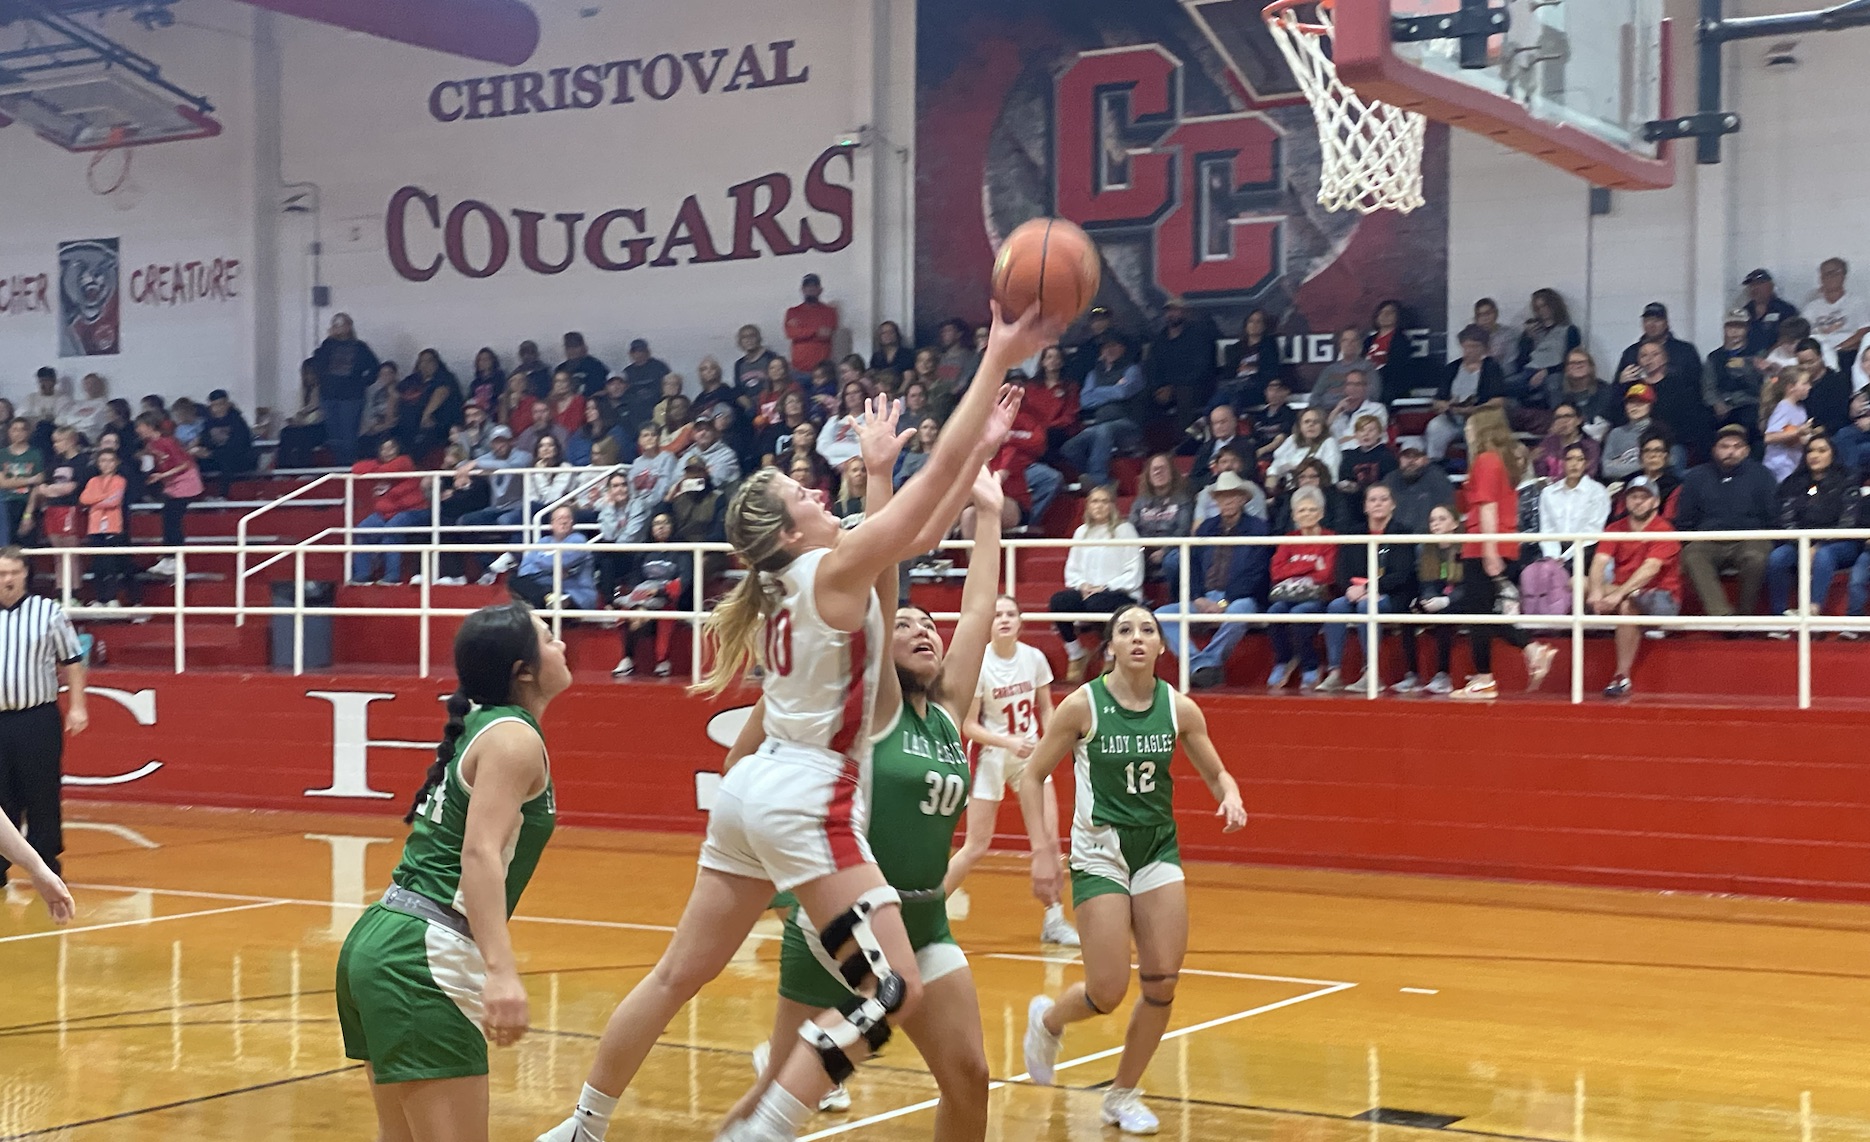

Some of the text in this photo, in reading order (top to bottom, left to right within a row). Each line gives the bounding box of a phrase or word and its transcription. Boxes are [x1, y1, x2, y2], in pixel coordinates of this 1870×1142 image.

[429, 39, 810, 122] CHRISTOVAL
[386, 144, 860, 282] COUGARS
[130, 257, 240, 305] CREATURE
[1002, 699, 1032, 735] 13
[1101, 734, 1173, 754] LADY EAGLES
[919, 769, 965, 816] 30
[1124, 761, 1157, 795] 12
